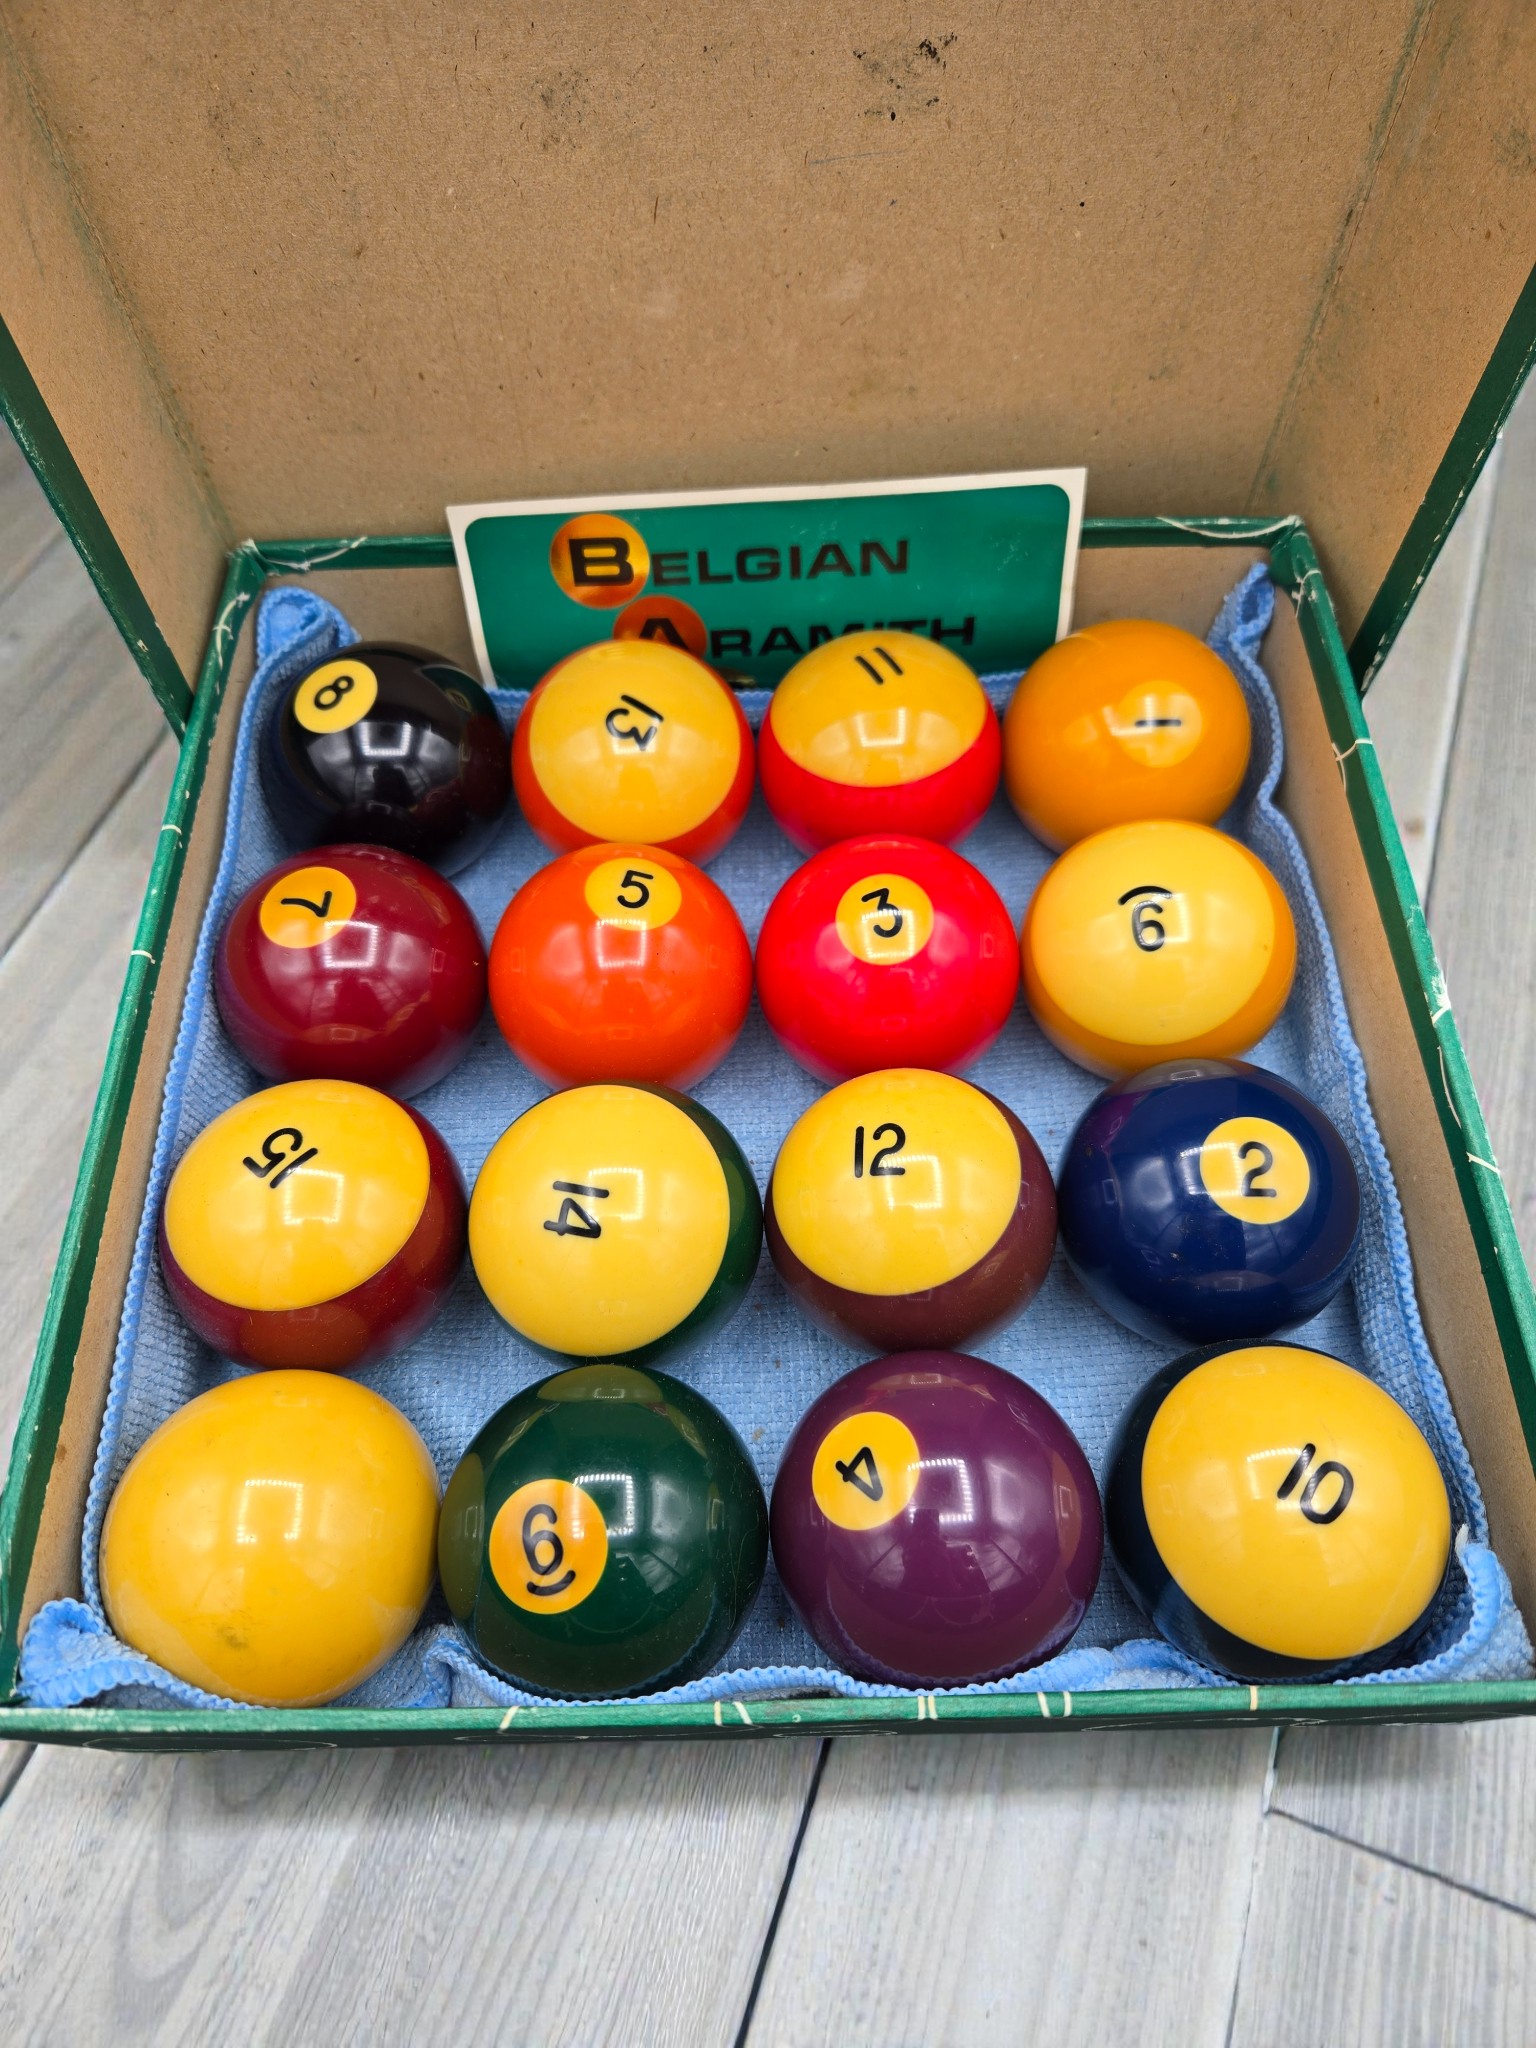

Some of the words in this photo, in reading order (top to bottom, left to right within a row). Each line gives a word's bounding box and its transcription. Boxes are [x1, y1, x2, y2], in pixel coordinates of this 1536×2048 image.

[567, 536, 910, 588] BELGIAN
[313, 675, 355, 711] 8
[854, 646, 904, 685] 11
[604, 694, 664, 751] 13
[1134, 717, 1183, 729] 1
[280, 890, 333, 919] 7
[616, 869, 654, 909] 5
[860, 887, 903, 938] 3
[242, 1127, 319, 1189] 15
[854, 1122, 906, 1179] 12
[1237, 1140, 1277, 1198] 2
[543, 1180, 610, 1239] 14
[834, 1446, 882, 1502] 4
[1276, 1442, 1354, 1525] 10
[522, 1504, 577, 1597] 6
